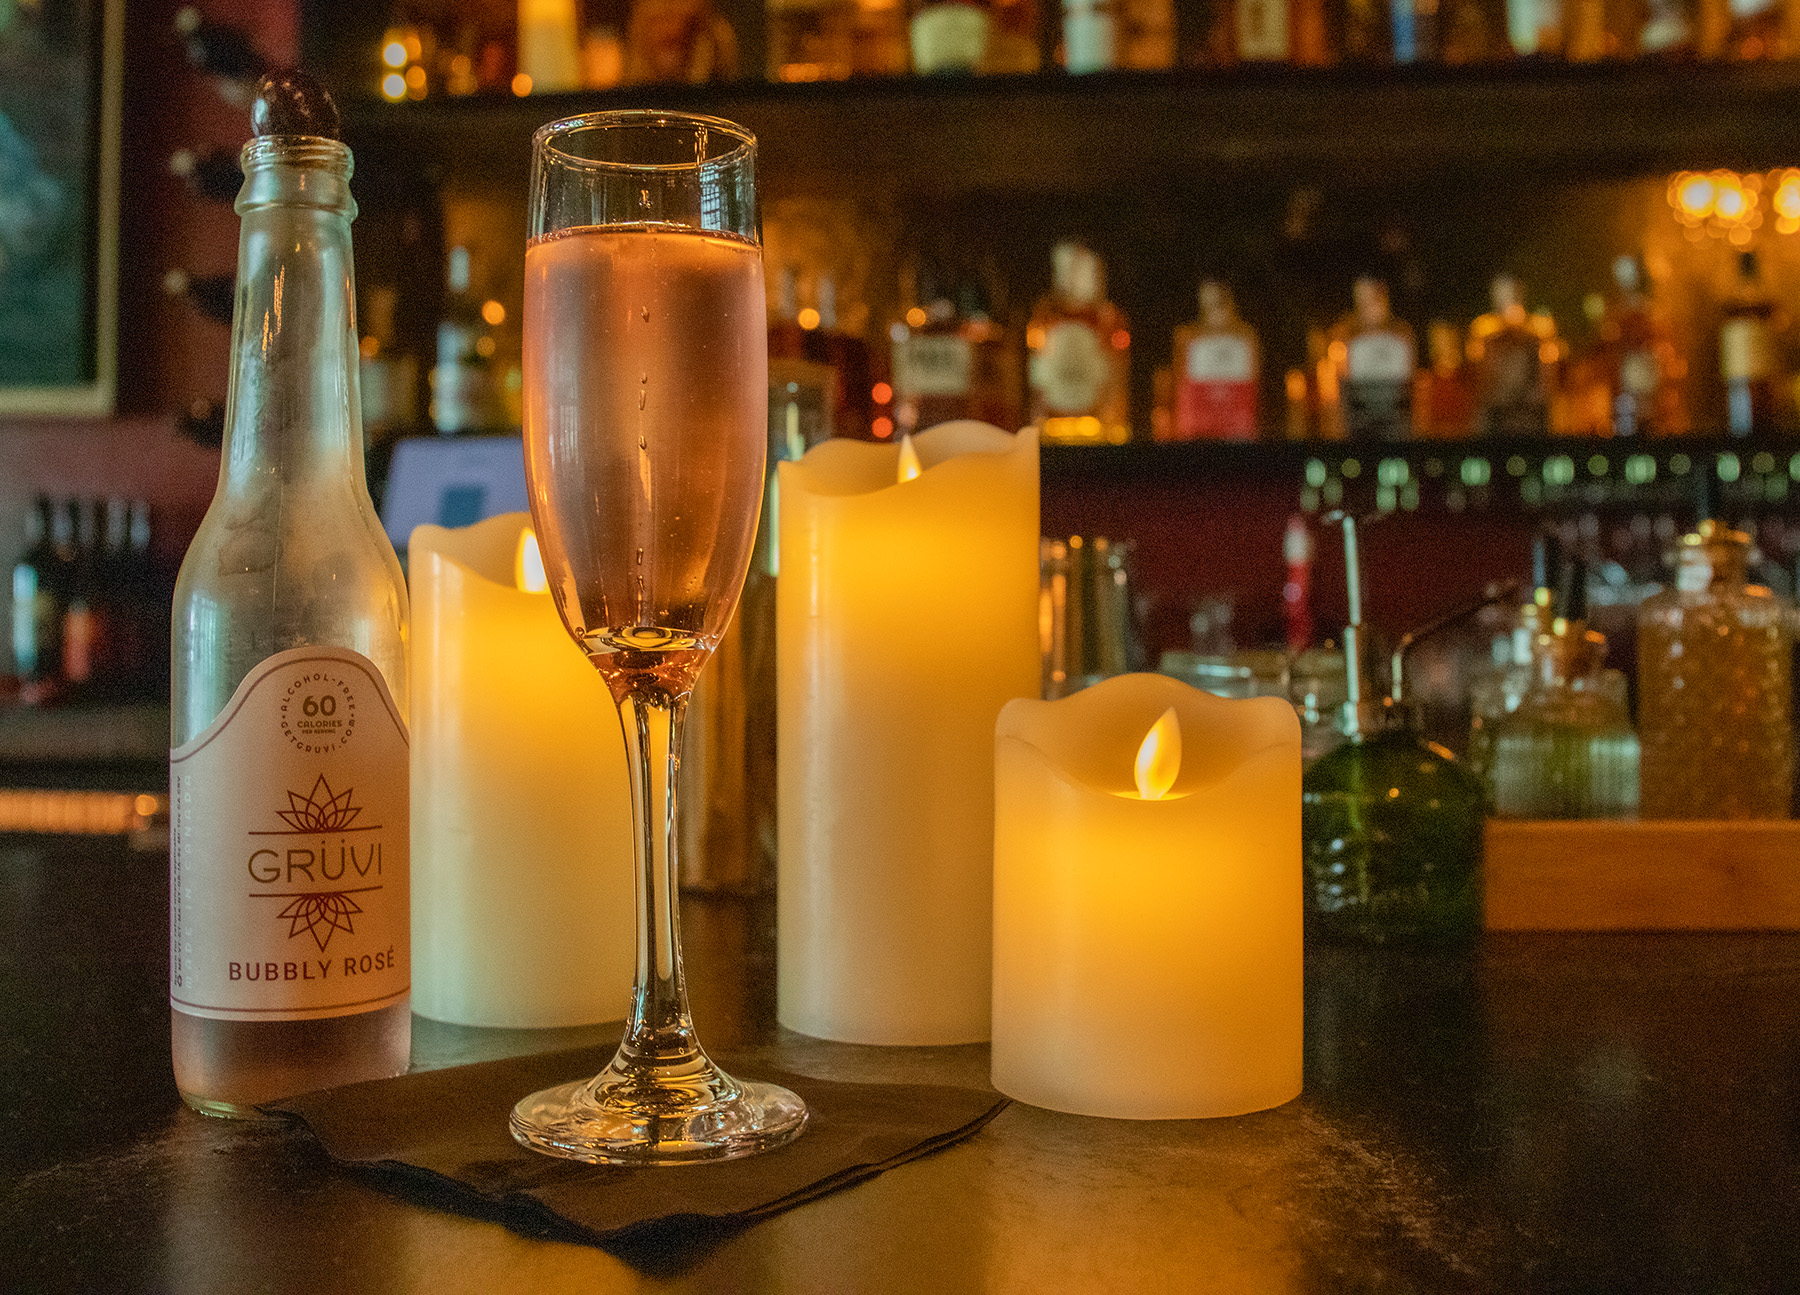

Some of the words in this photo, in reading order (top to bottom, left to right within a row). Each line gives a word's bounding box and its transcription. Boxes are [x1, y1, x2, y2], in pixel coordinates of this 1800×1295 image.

[280, 673, 356, 712] ALCOHOL-FREE
[302, 695, 337, 717] 60
[280, 720, 356, 754] GETGRUVI.COM
[297, 720, 343, 729] CALORIES
[184, 775, 192, 871] CANADA
[248, 839, 382, 883] GRÜVI
[184, 887, 192, 910] IN
[184, 926, 193, 990] MADE
[229, 960, 332, 981] BUBBLY
[344, 944, 395, 977] ROSÉ
